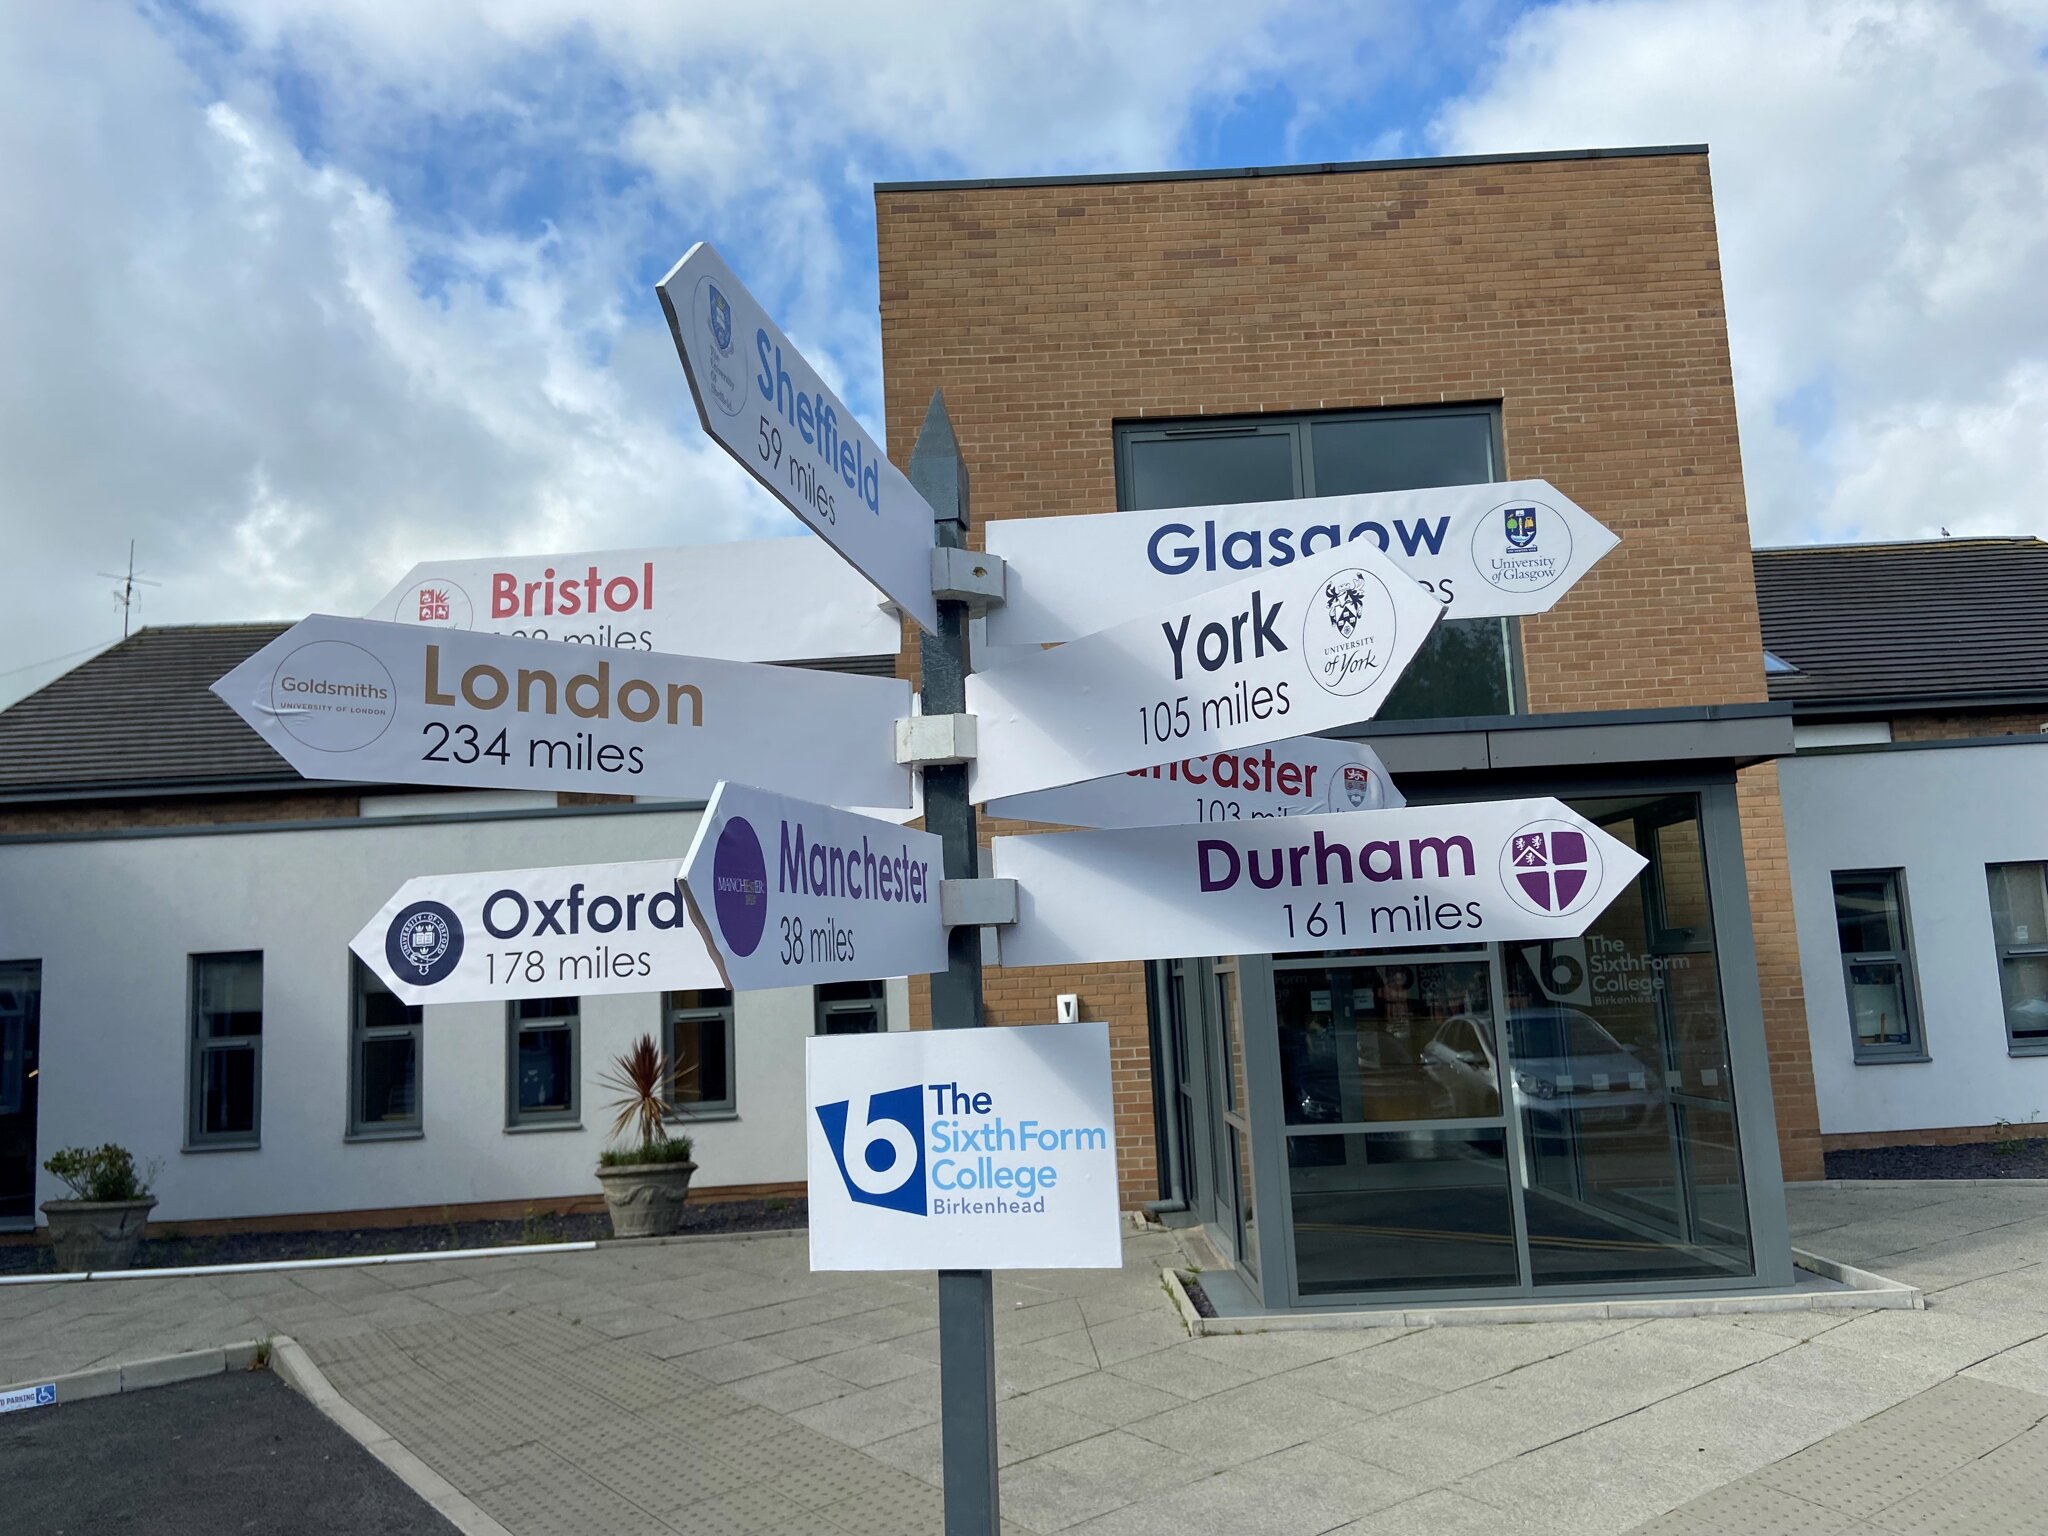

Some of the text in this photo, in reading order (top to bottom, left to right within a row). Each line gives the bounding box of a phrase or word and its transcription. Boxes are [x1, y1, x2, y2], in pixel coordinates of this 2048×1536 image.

[756, 328, 879, 516] Sheffield
[757, 415, 836, 525] 59 miles
[1491, 555, 1555, 569] University
[1492, 569, 1556, 584] of Glasgow
[491, 562, 653, 619] Bristol
[1162, 590, 1288, 680] York
[1324, 636, 1374, 655] UNIVERSITY
[281, 677, 388, 699] Goldsmiths
[424, 644, 703, 727] London
[1324, 649, 1378, 687] of York
[280, 703, 332, 711] UNIVERSITY
[350, 707, 386, 715] LONDON
[1139, 680, 1290, 745] 105 miles
[421, 722, 644, 775] 234 miles
[779, 820, 928, 904] Manchester
[1196, 831, 1477, 892] Durham
[482, 878, 684, 939] Oxford
[1283, 896, 1484, 938] 161 miles
[780, 916, 855, 965] 38 miles
[1586, 934, 1624, 953] The
[486, 946, 651, 985] 178 miles
[1592, 974, 1664, 995] College
[1594, 995, 1658, 1006] Birkenhead
[928, 1082, 993, 1115] The
[931, 1157, 1057, 1198] College
[933, 1197, 1045, 1215] Birkenhead
[6, 1393, 35, 1404] PARKING
